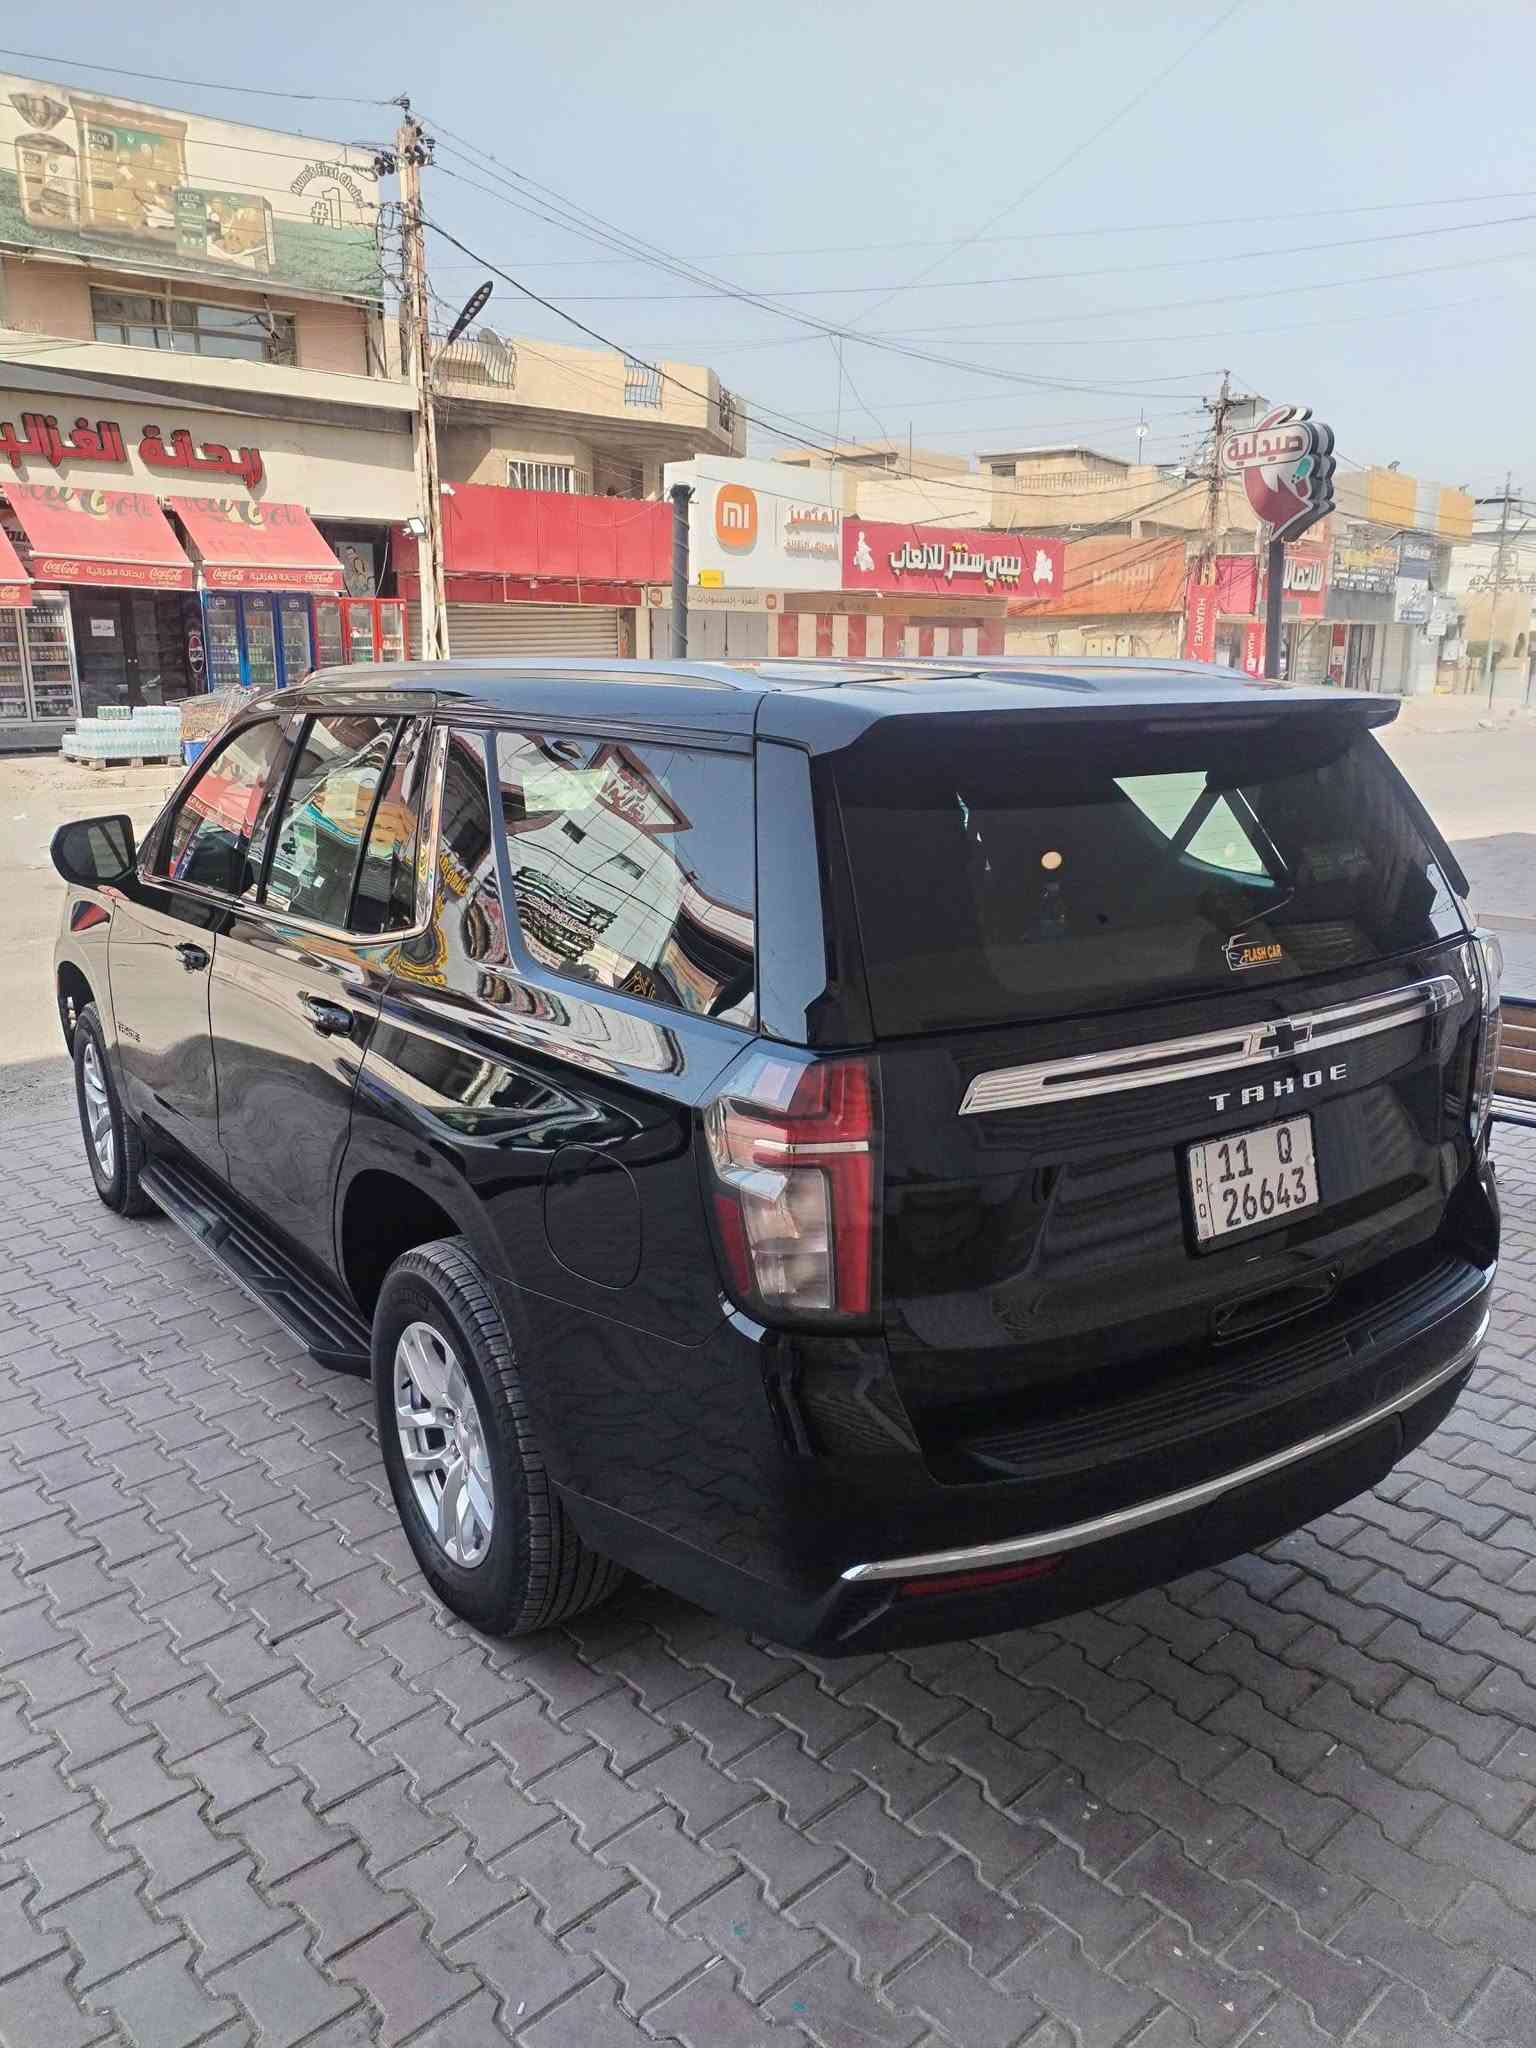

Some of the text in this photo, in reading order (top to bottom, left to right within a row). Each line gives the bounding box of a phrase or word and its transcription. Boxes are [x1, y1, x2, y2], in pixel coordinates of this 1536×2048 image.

[0, 412, 128, 467] الغزالي
[1228, 433, 1303, 467] صيدلية
[944, 542, 985, 580] سنتر
[1193, 598, 1206, 647] HUAWEI
[1208, 1063, 1348, 1111] TAHOE
[1218, 1127, 1293, 1183] 11 Q
[1222, 1166, 1307, 1228] 26643
